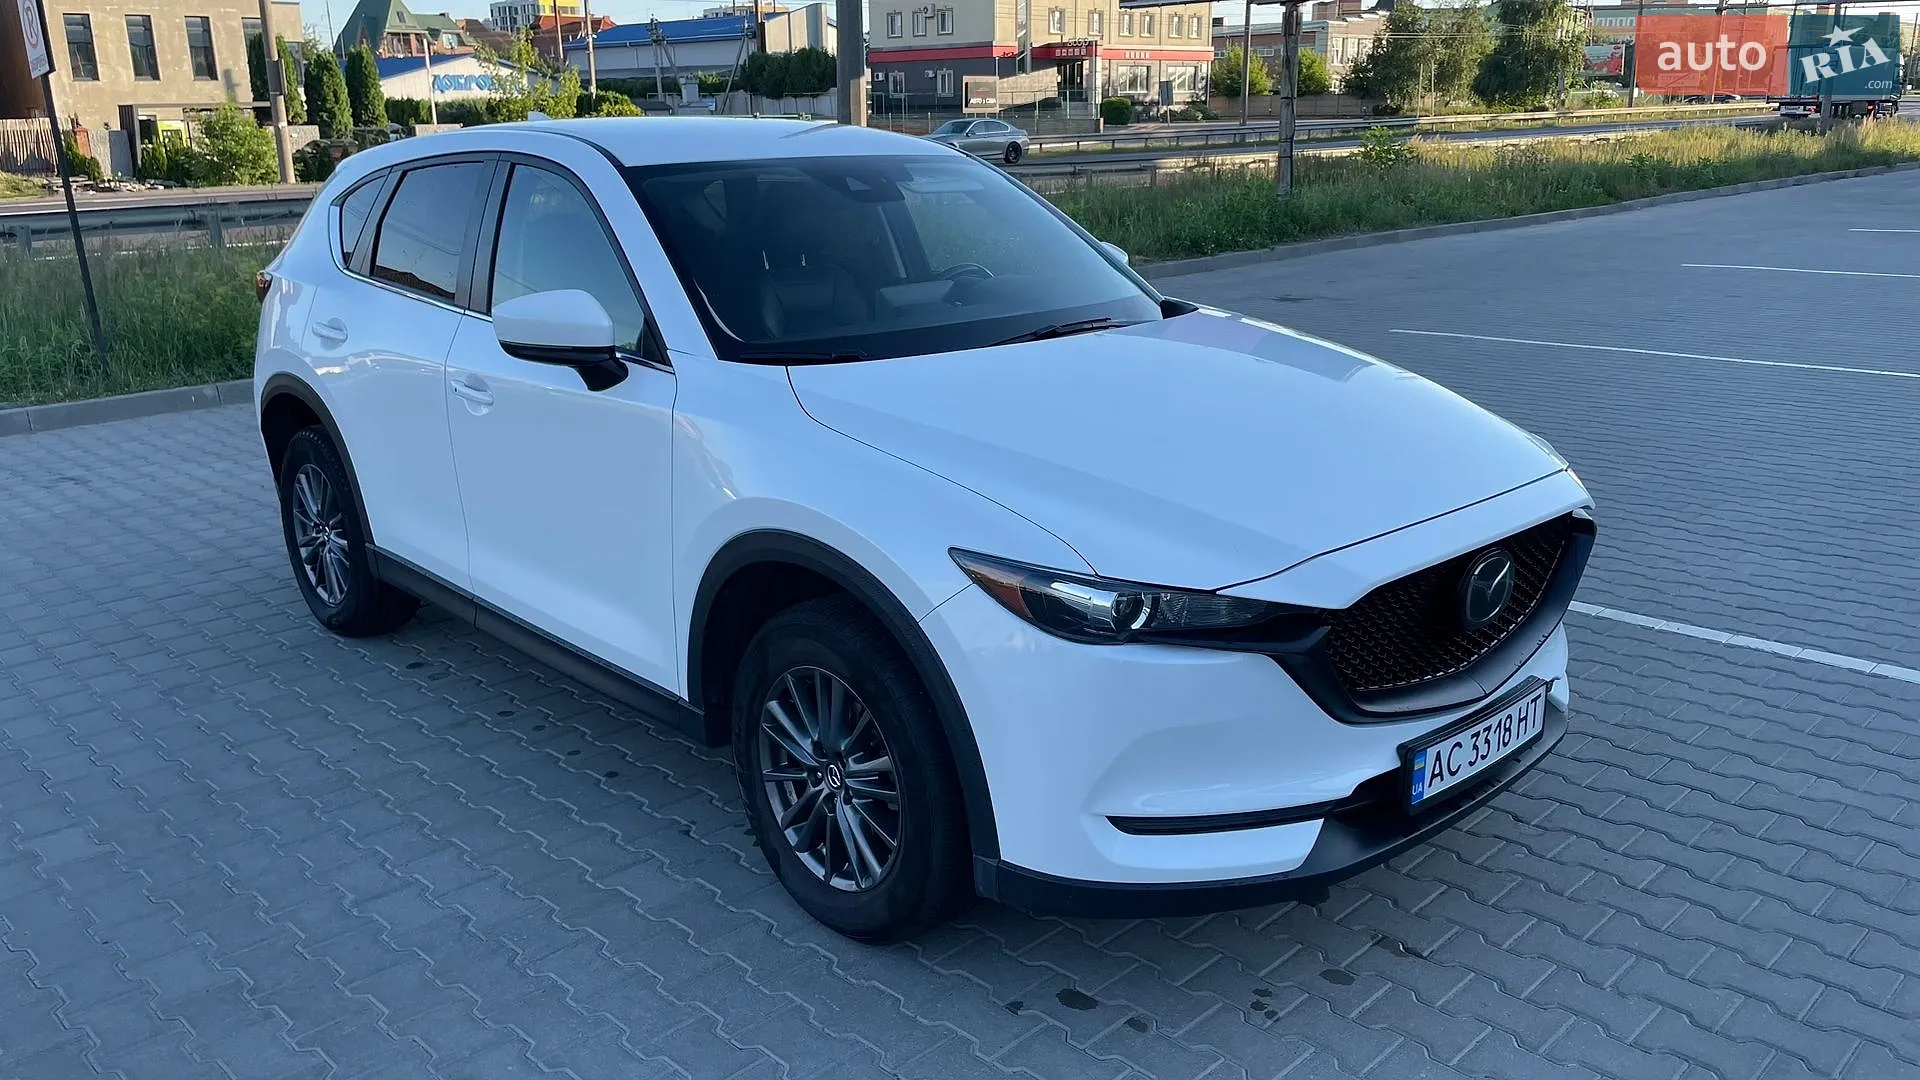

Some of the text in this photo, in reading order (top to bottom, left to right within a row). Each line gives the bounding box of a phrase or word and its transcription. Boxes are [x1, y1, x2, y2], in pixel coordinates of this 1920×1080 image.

[1428, 693, 1542, 788] AC 3318 HT
[1412, 782, 1423, 796] UA
